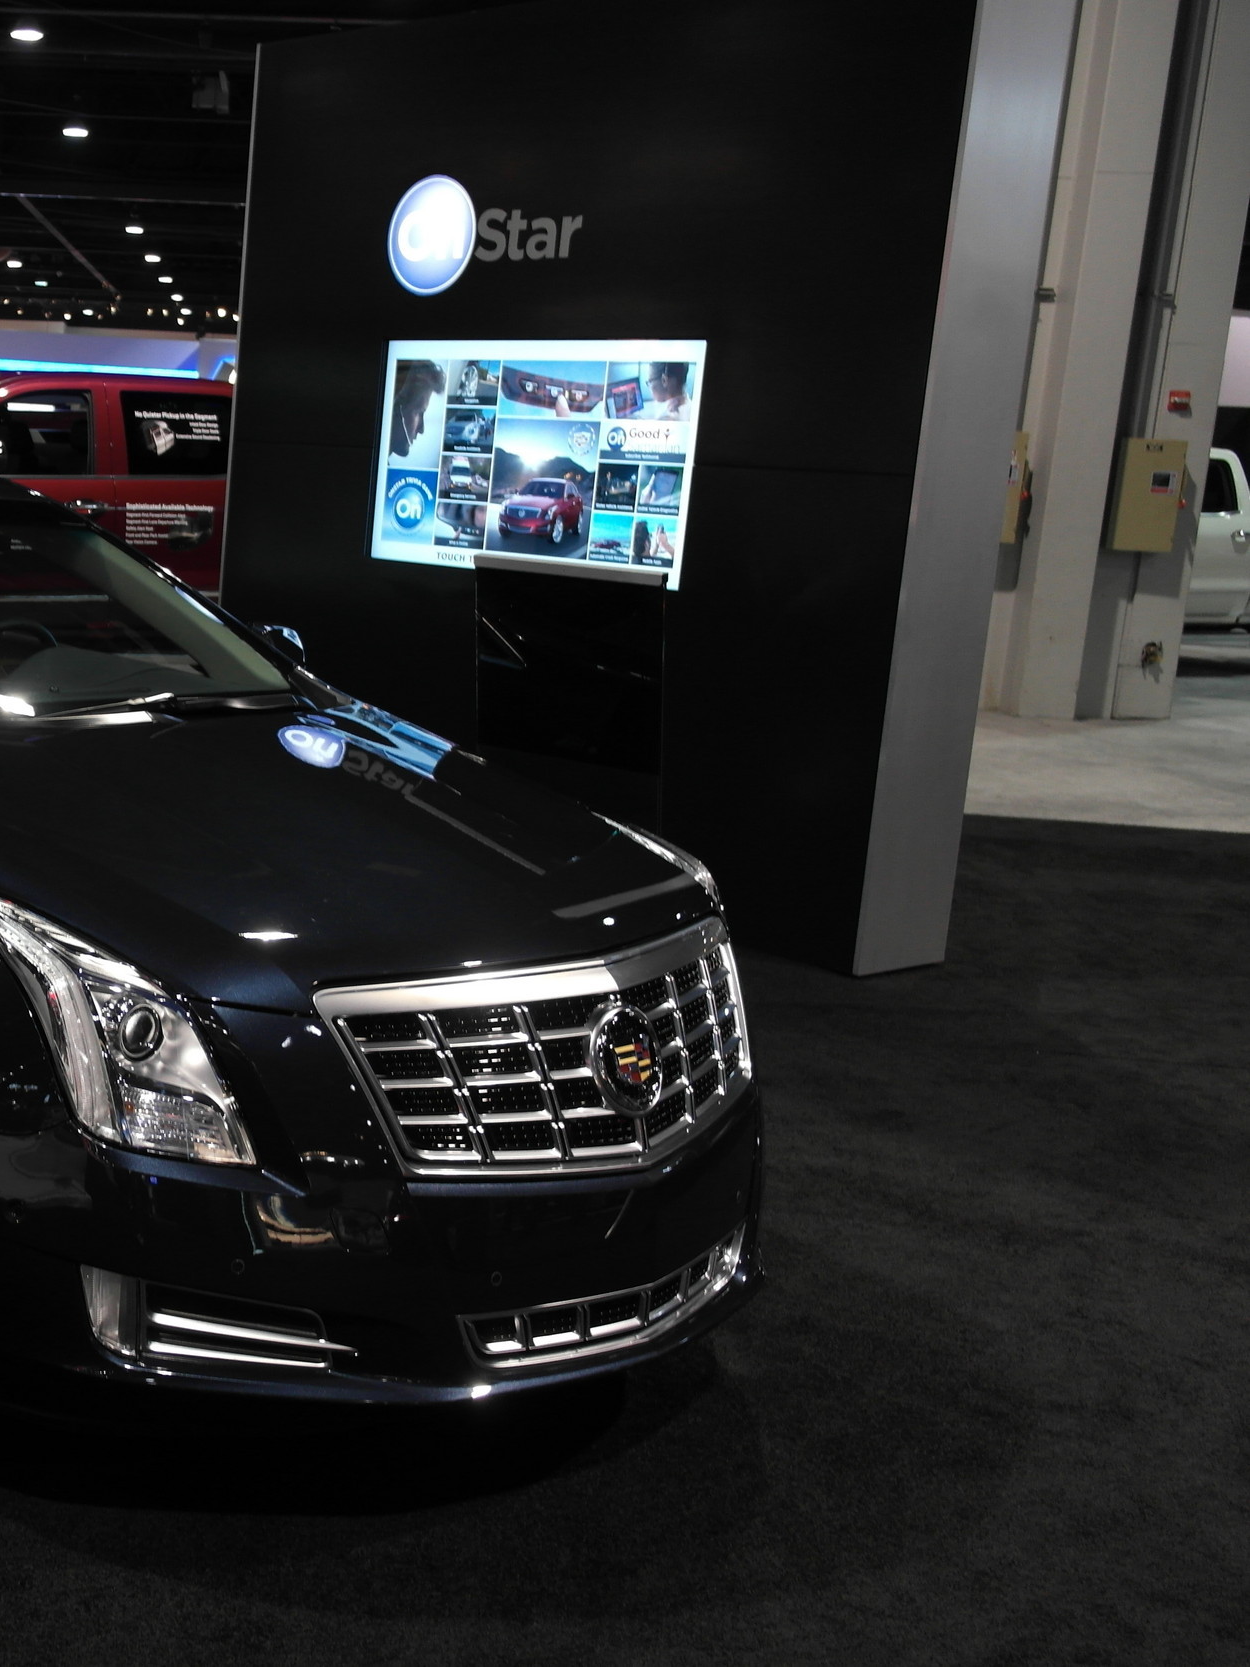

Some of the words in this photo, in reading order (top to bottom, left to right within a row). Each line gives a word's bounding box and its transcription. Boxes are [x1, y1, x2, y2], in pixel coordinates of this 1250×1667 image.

[143, 410, 161, 419] Quieter
[162, 411, 180, 420] Pickup
[629, 428, 661, 439] Good
[126, 502, 162, 511] Sophisticated
[185, 503, 214, 513] Technology
[396, 498, 422, 520] On
[437, 552, 466, 561] TOUCH
